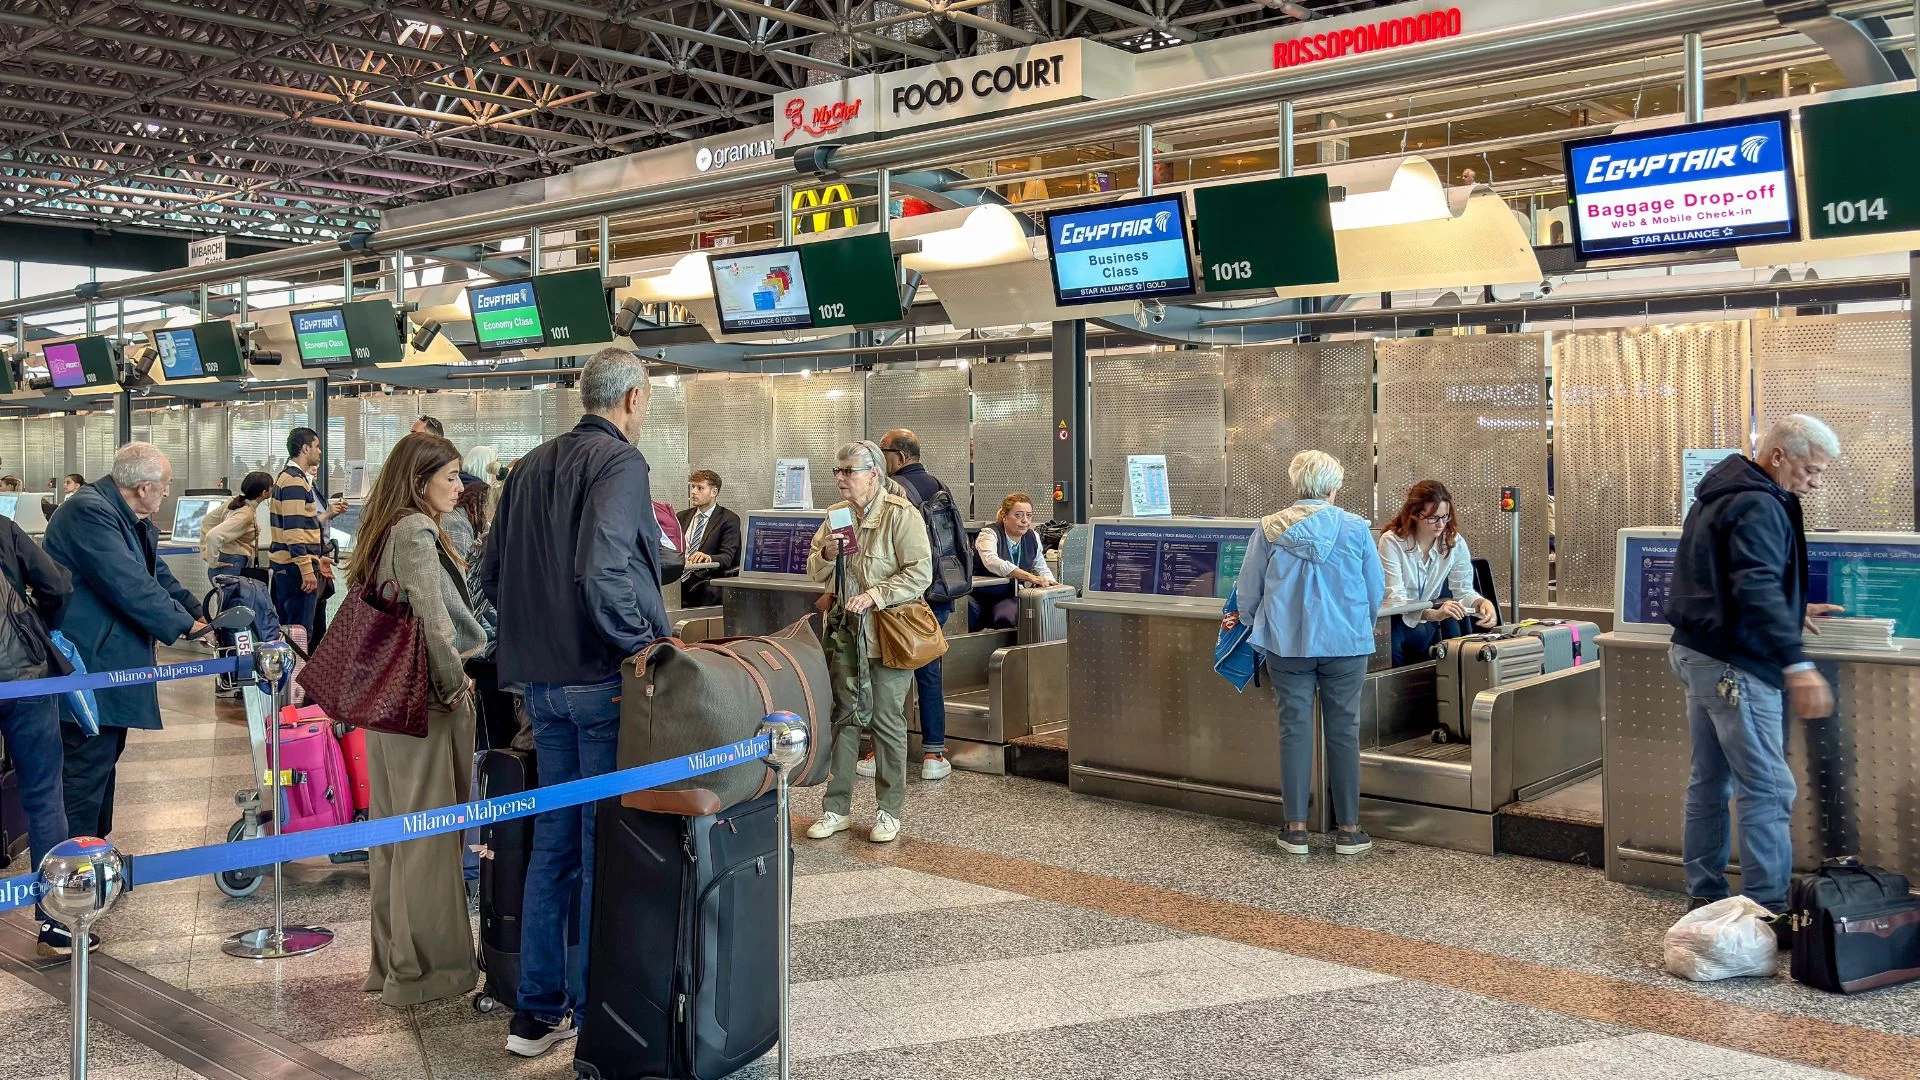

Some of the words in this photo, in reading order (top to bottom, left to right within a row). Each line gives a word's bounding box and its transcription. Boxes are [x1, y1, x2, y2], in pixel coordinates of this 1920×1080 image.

[1273, 8, 1461, 69] ROSSOPOMODORO
[893, 76, 964, 114] FOOD
[972, 55, 1064, 97] COURT
[812, 98, 862, 125] MyChef
[1584, 144, 1738, 185] EGYPTAIR
[1587, 197, 1675, 218] Baggage
[1684, 184, 1775, 208] Drop-off
[1822, 197, 1888, 225] 1014
[1611, 218, 1635, 229] Web
[1640, 218, 1648, 226] &
[1652, 213, 1692, 225] Mobile
[1697, 207, 1752, 220] Check-in
[1059, 217, 1153, 246] EGYPTAIR
[1631, 235, 1661, 245] STAR
[1663, 229, 1720, 242] ALLIANCE
[191, 242, 223, 259] IMBARCHI
[1088, 251, 1149, 266] Business
[1102, 267, 1139, 279] Class
[1211, 260, 1252, 281] 1013
[1080, 287, 1098, 295] STAR
[1099, 284, 1134, 294] ALLIANCE
[1146, 281, 1167, 289] GOLD
[818, 303, 845, 319] 1012
[483, 320, 513, 331] Economy
[514, 317, 534, 327] Class
[737, 319, 750, 327] STAR
[750, 317, 774, 325] ALLIANCE
[550, 326, 570, 340] 1011
[108, 670, 147, 684] Milano
[151, 664, 204, 679] Malpensa
[687, 752, 728, 772] Milano
[403, 812, 456, 835] Milano
[465, 796, 536, 822] Malpensa
